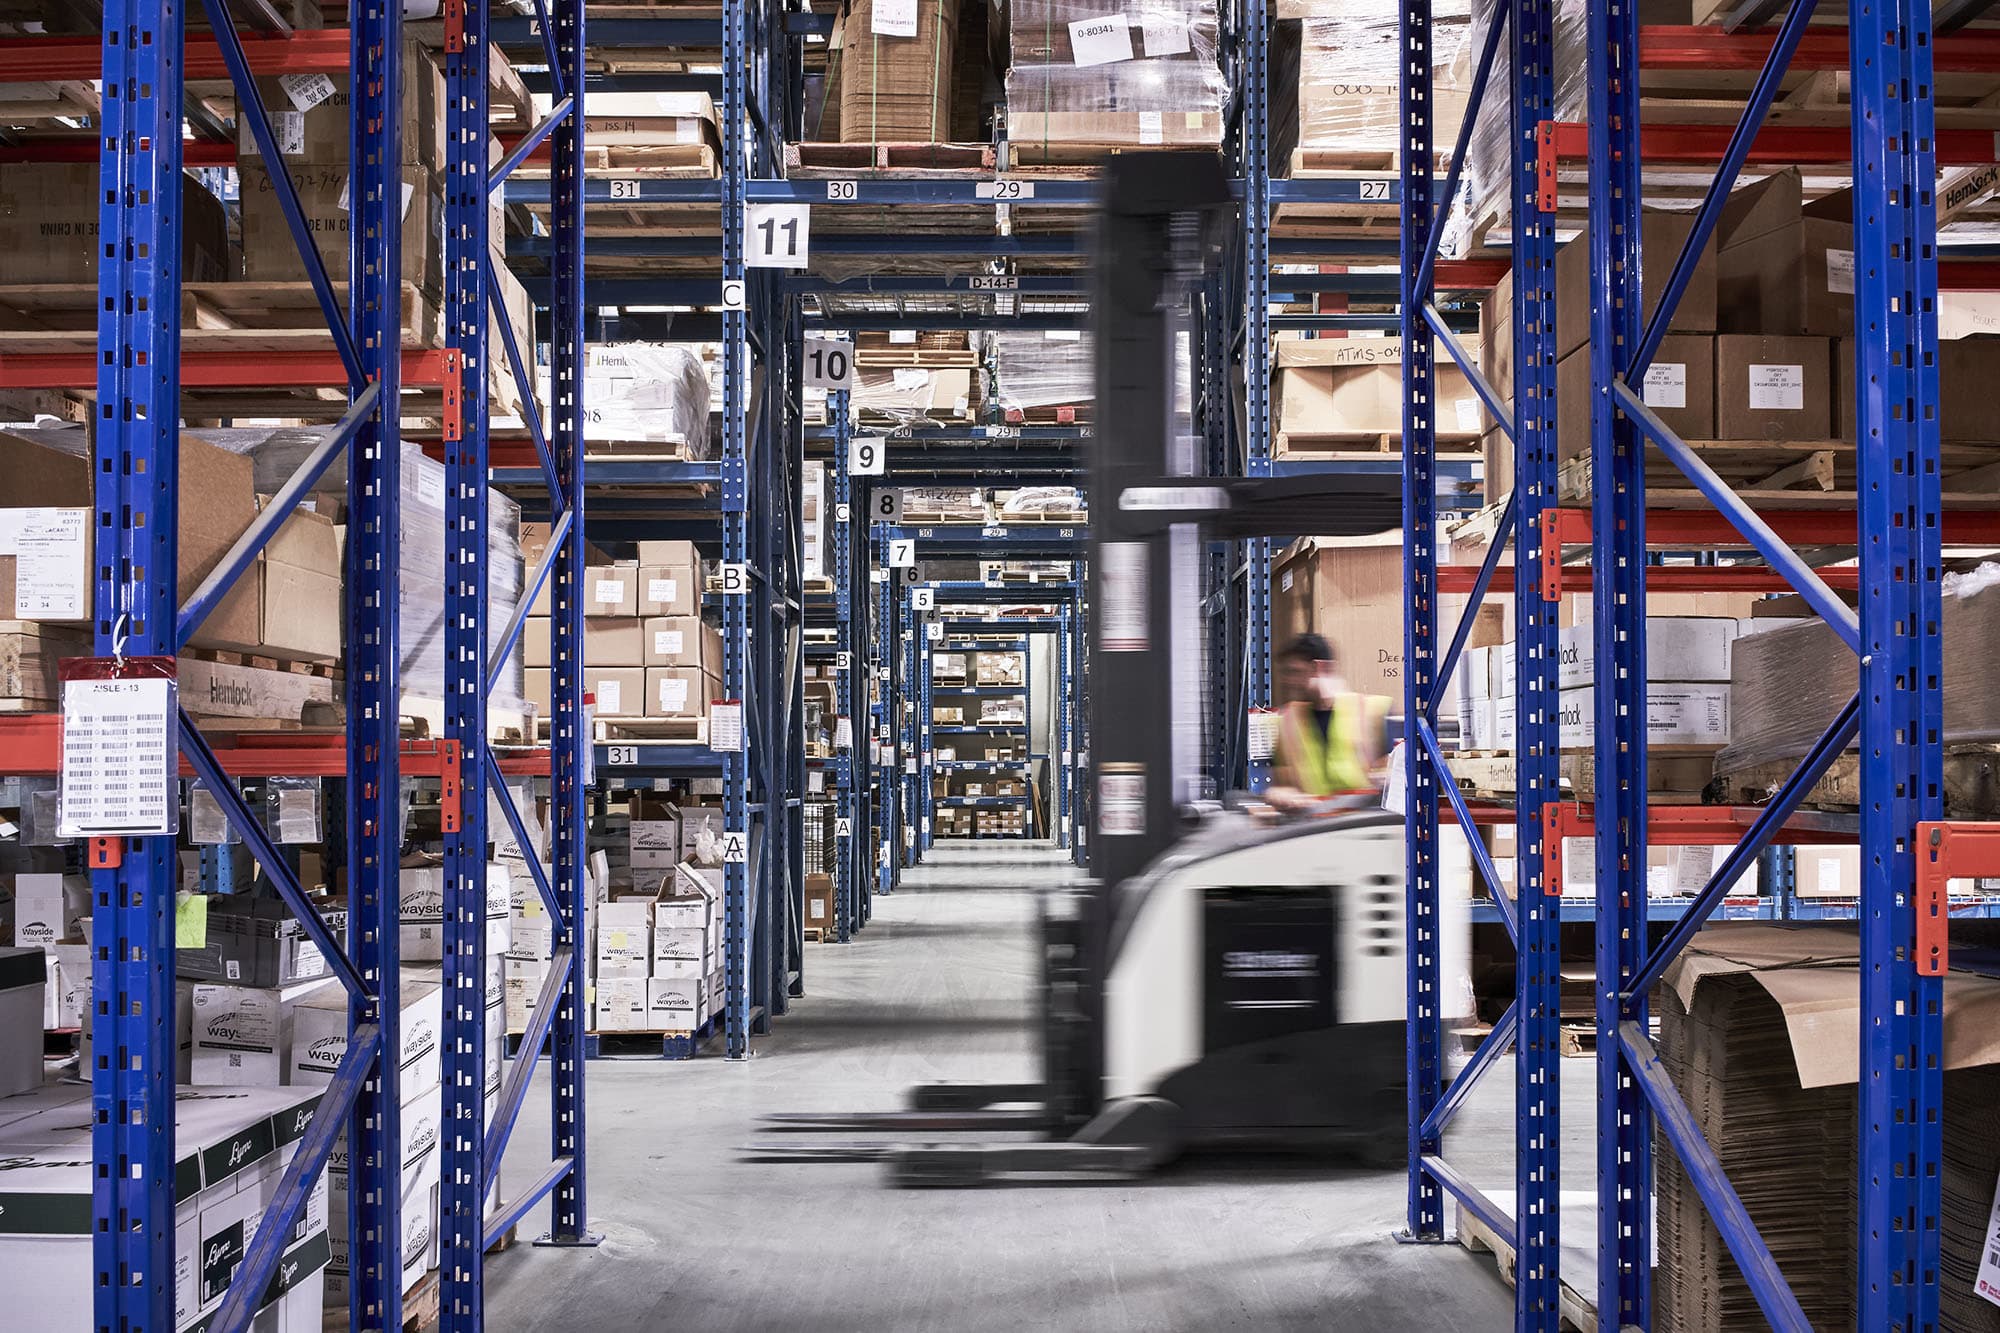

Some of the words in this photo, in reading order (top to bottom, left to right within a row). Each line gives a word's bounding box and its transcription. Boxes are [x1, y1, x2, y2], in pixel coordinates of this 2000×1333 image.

[612, 181, 637, 198] 31
[829, 182, 854, 199] 30
[995, 182, 1020, 198] 29
[1362, 182, 1387, 199] 27
[40, 222, 71, 236] CHINA
[757, 217, 798, 256] 11
[972, 277, 1015, 289] D-14-F
[723, 284, 741, 307] C
[809, 349, 847, 381] 10
[859, 445, 874, 468] 9
[880, 494, 895, 515] 8
[836, 506, 848, 520] C
[919, 528, 932, 537] 30
[1060, 529, 1073, 537] 28
[896, 545, 908, 562] 7
[723, 568, 741, 590] B
[880, 569, 889, 580] D
[907, 566, 918, 582] 6
[918, 593, 928, 606] 5
[926, 609, 936, 620] 4
[931, 625, 939, 637] 3
[837, 654, 848, 667] B
[880, 668, 889, 679] C
[129, 684, 139, 692] 13
[210, 676, 253, 706] Hemlock
[881, 726, 889, 737] B
[610, 748, 634, 764] 31
[838, 820, 850, 834] A
[725, 836, 743, 858] A
[400, 903, 443, 917] waysid
[22, 927, 54, 937] Wayside
[656, 997, 690, 1007] wayside
[403, 1029, 433, 1056] wayside
[407, 1127, 434, 1154] wayside
